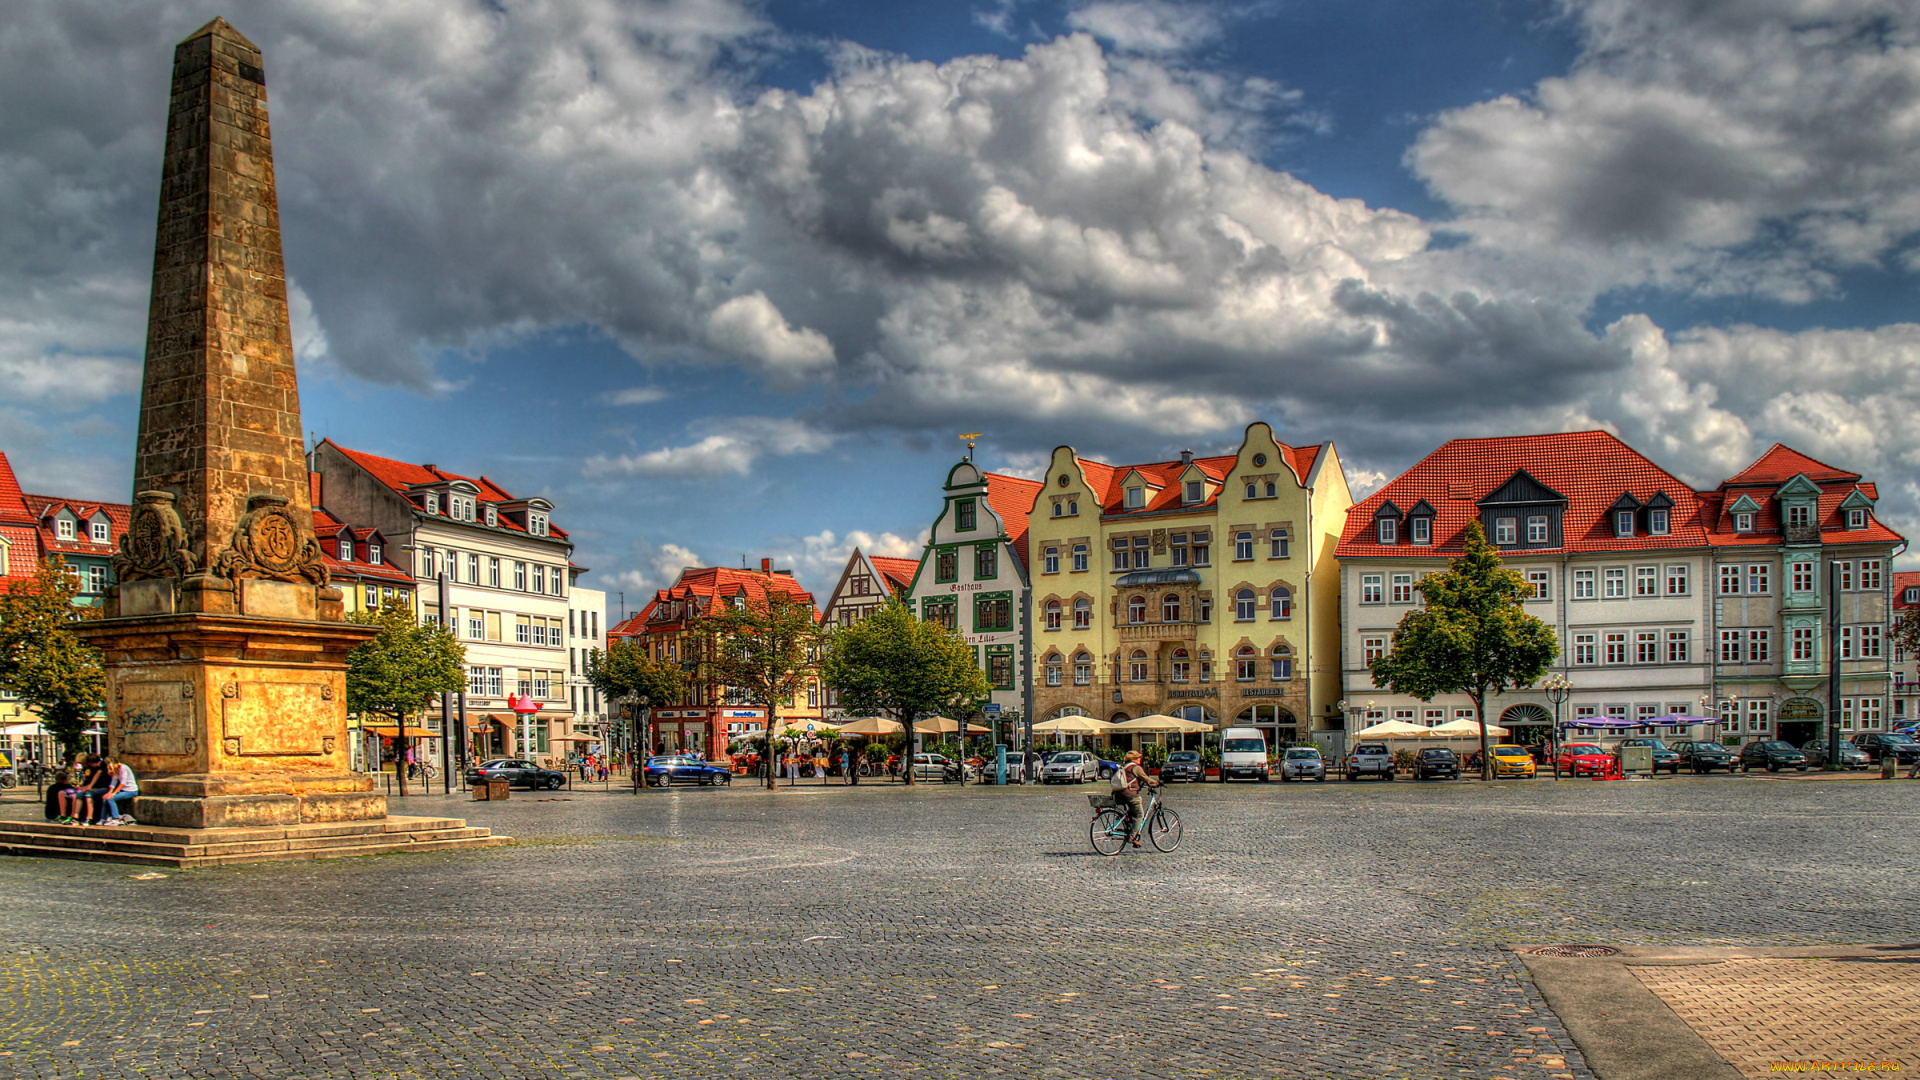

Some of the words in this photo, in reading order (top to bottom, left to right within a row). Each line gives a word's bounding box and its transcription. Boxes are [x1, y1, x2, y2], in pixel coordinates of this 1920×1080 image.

[950, 583, 982, 592] Gasthaus
[978, 634, 995, 643] Lilie
[1243, 688, 1284, 697] RESTAURANT
